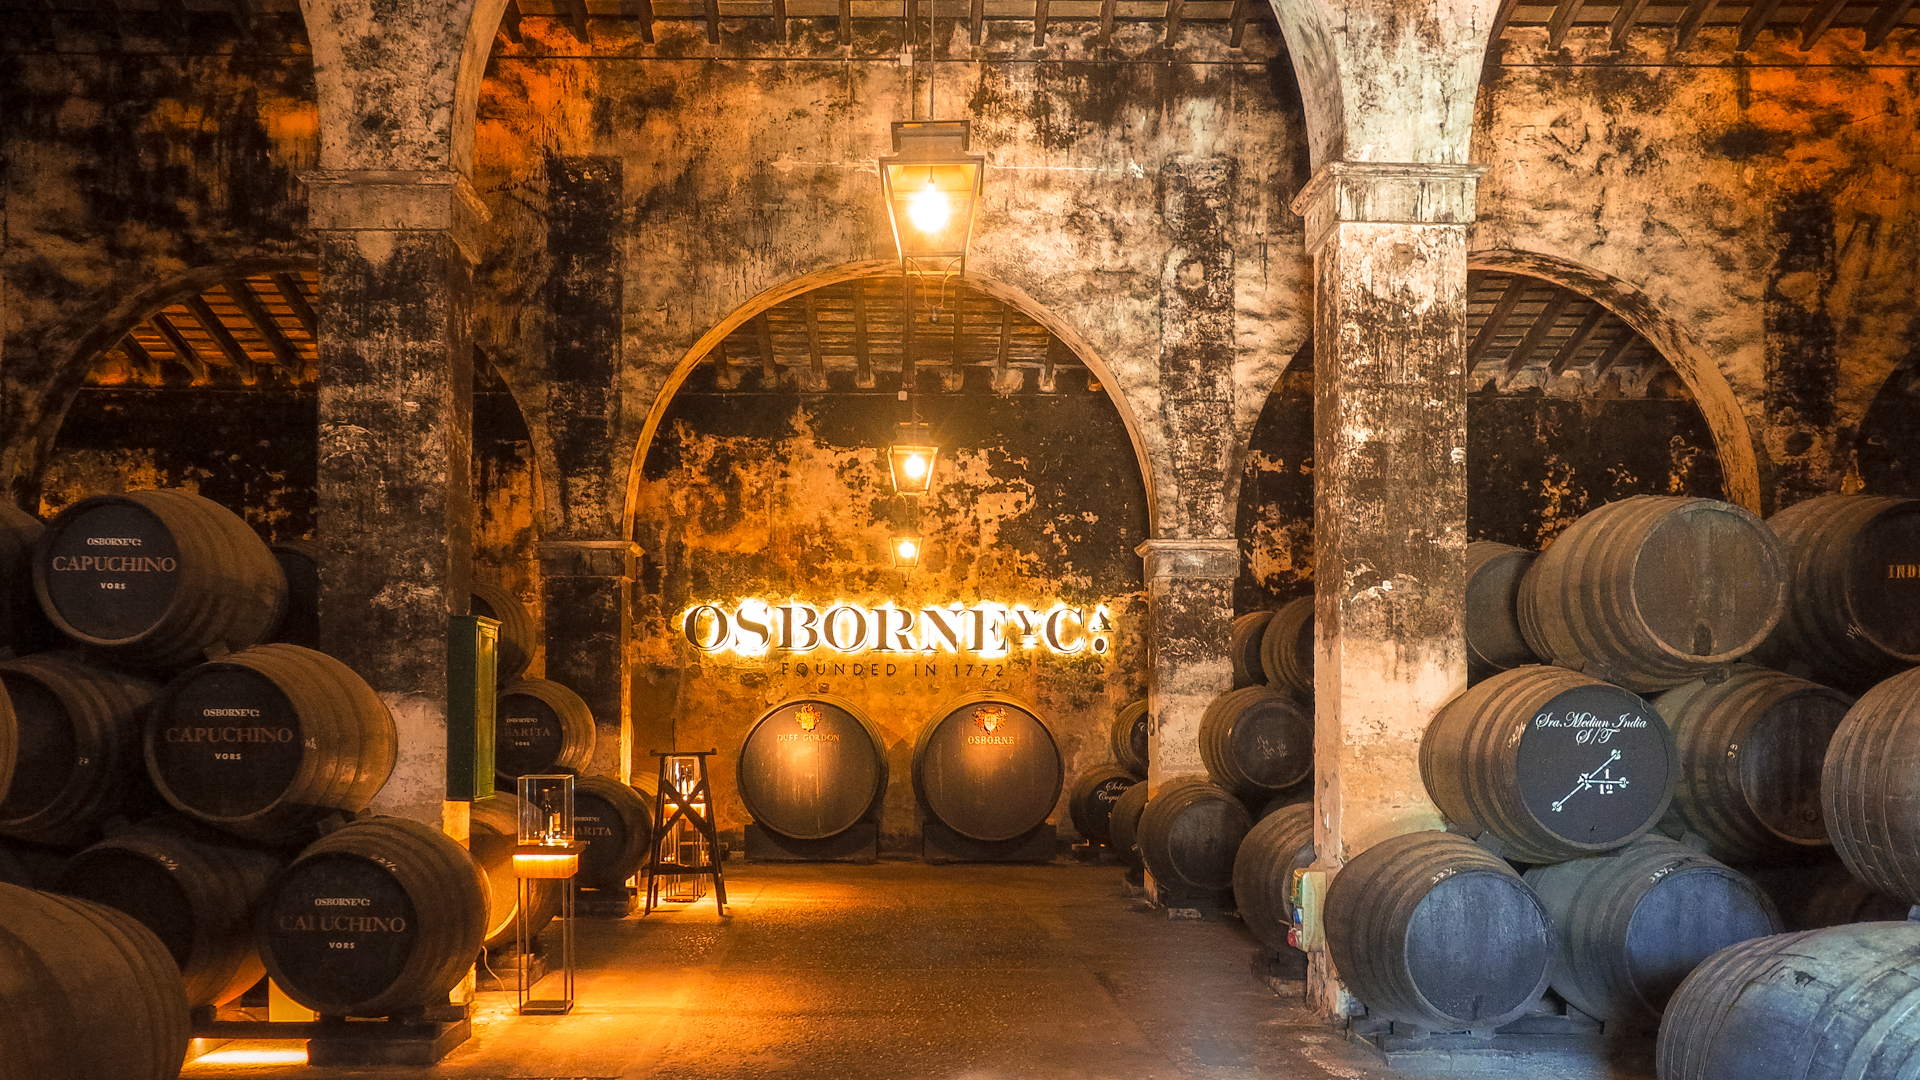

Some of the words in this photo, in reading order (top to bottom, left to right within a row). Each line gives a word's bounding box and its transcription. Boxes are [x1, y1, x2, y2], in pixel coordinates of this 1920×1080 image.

[52, 555, 177, 572] CAPUCHINO
[1888, 564, 1920, 579] IND
[100, 582, 126, 590] VORS
[684, 604, 1009, 654] OSBORNE
[781, 662, 897, 677] FOUNDED
[914, 663, 937, 677] IN
[953, 663, 1004, 677] 1772
[1611, 712, 1648, 728] India
[166, 726, 294, 744] CAPUCHINO
[777, 734, 799, 742] DUFF
[802, 734, 840, 742] GORDON
[967, 735, 1015, 745] OSBORNE
[214, 752, 242, 760] VORS
[328, 942, 355, 950] VORS
